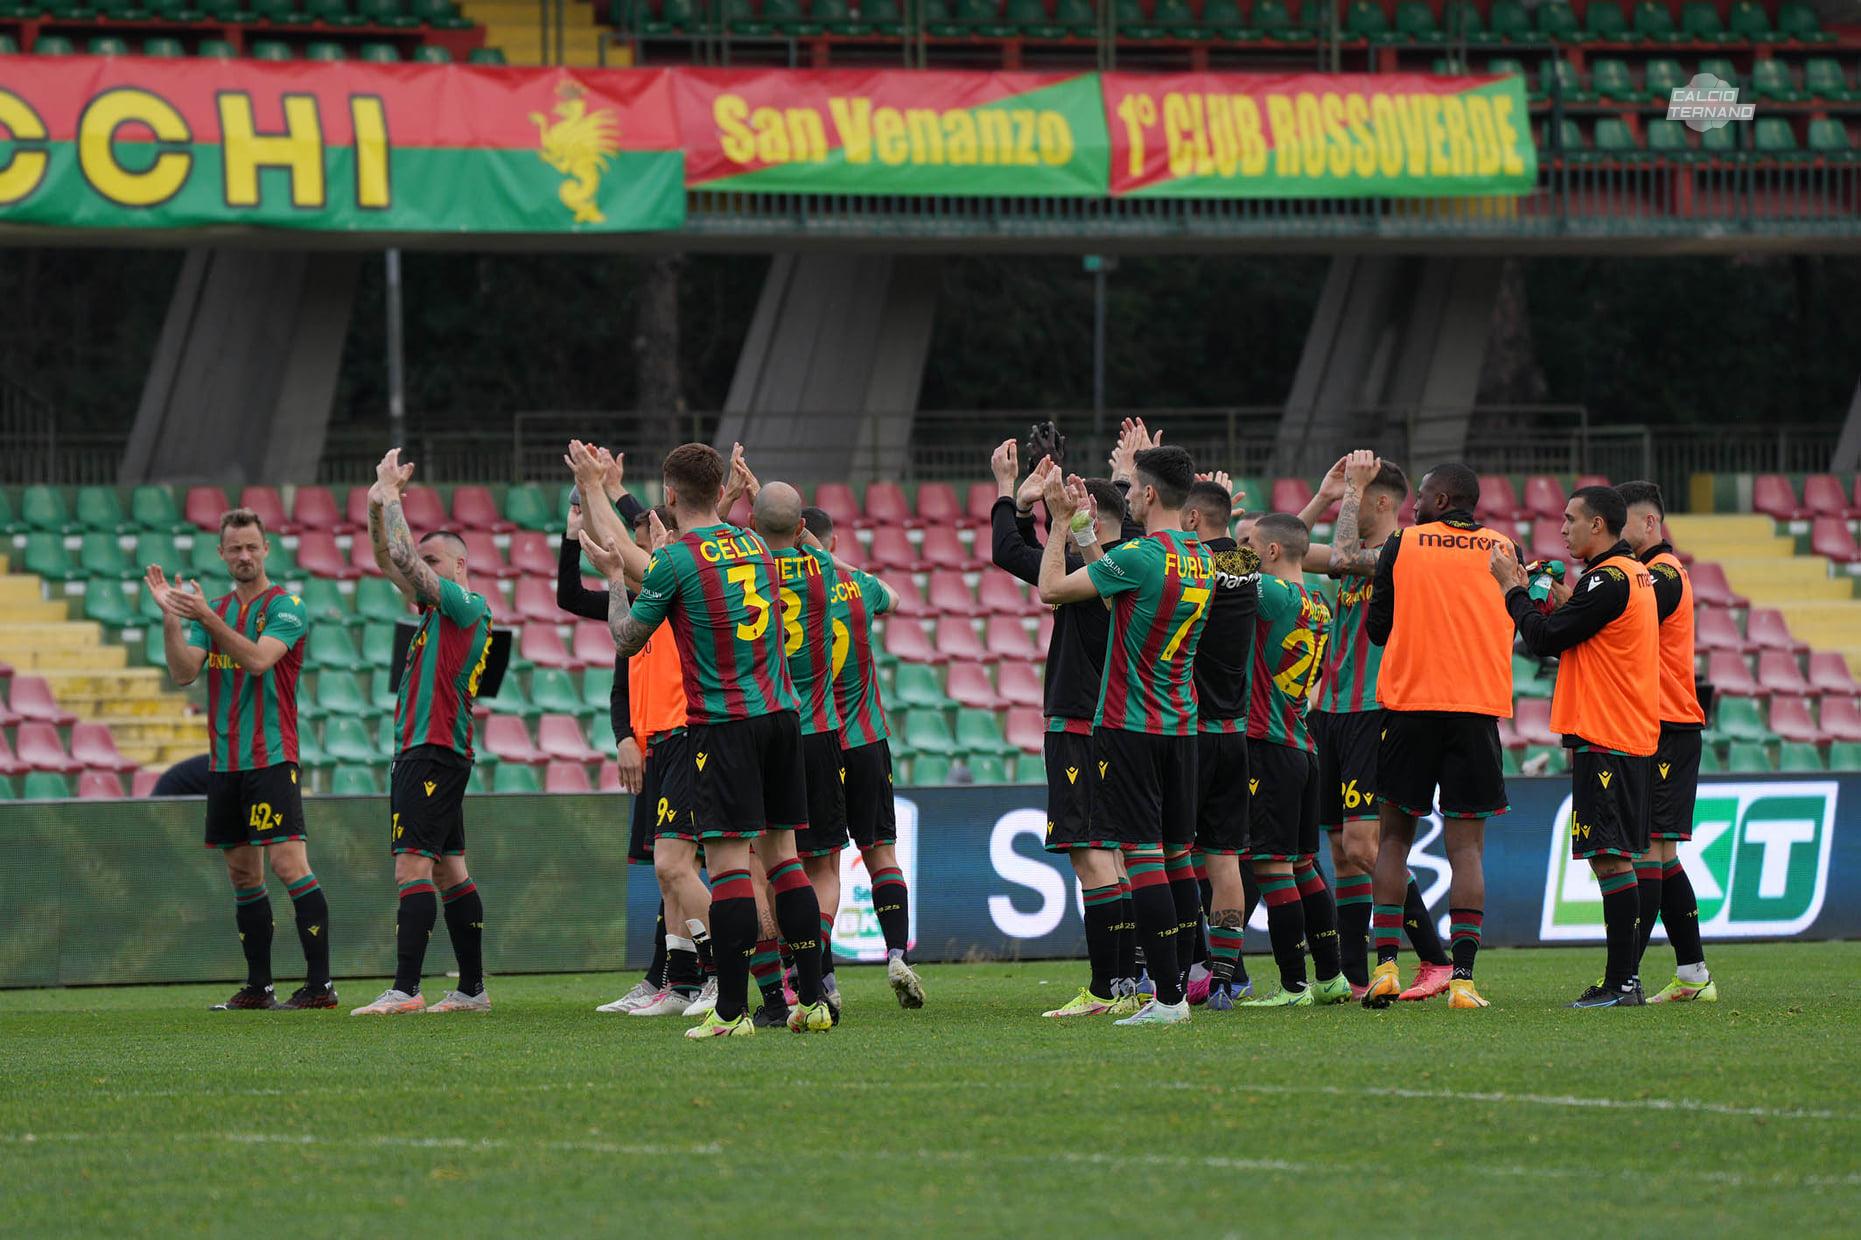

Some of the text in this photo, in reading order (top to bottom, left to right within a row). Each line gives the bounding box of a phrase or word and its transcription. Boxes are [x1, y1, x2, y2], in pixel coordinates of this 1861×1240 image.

[713, 93, 1074, 166] San Venanzo
[1162, 92, 1269, 178] CLUB
[1271, 93, 1526, 178] ROSSOVERDE
[699, 535, 765, 562] CELLI
[726, 564, 771, 641] 3
[1160, 586, 1211, 661] 7
[249, 802, 273, 831] 42
[988, 808, 1085, 938] S
